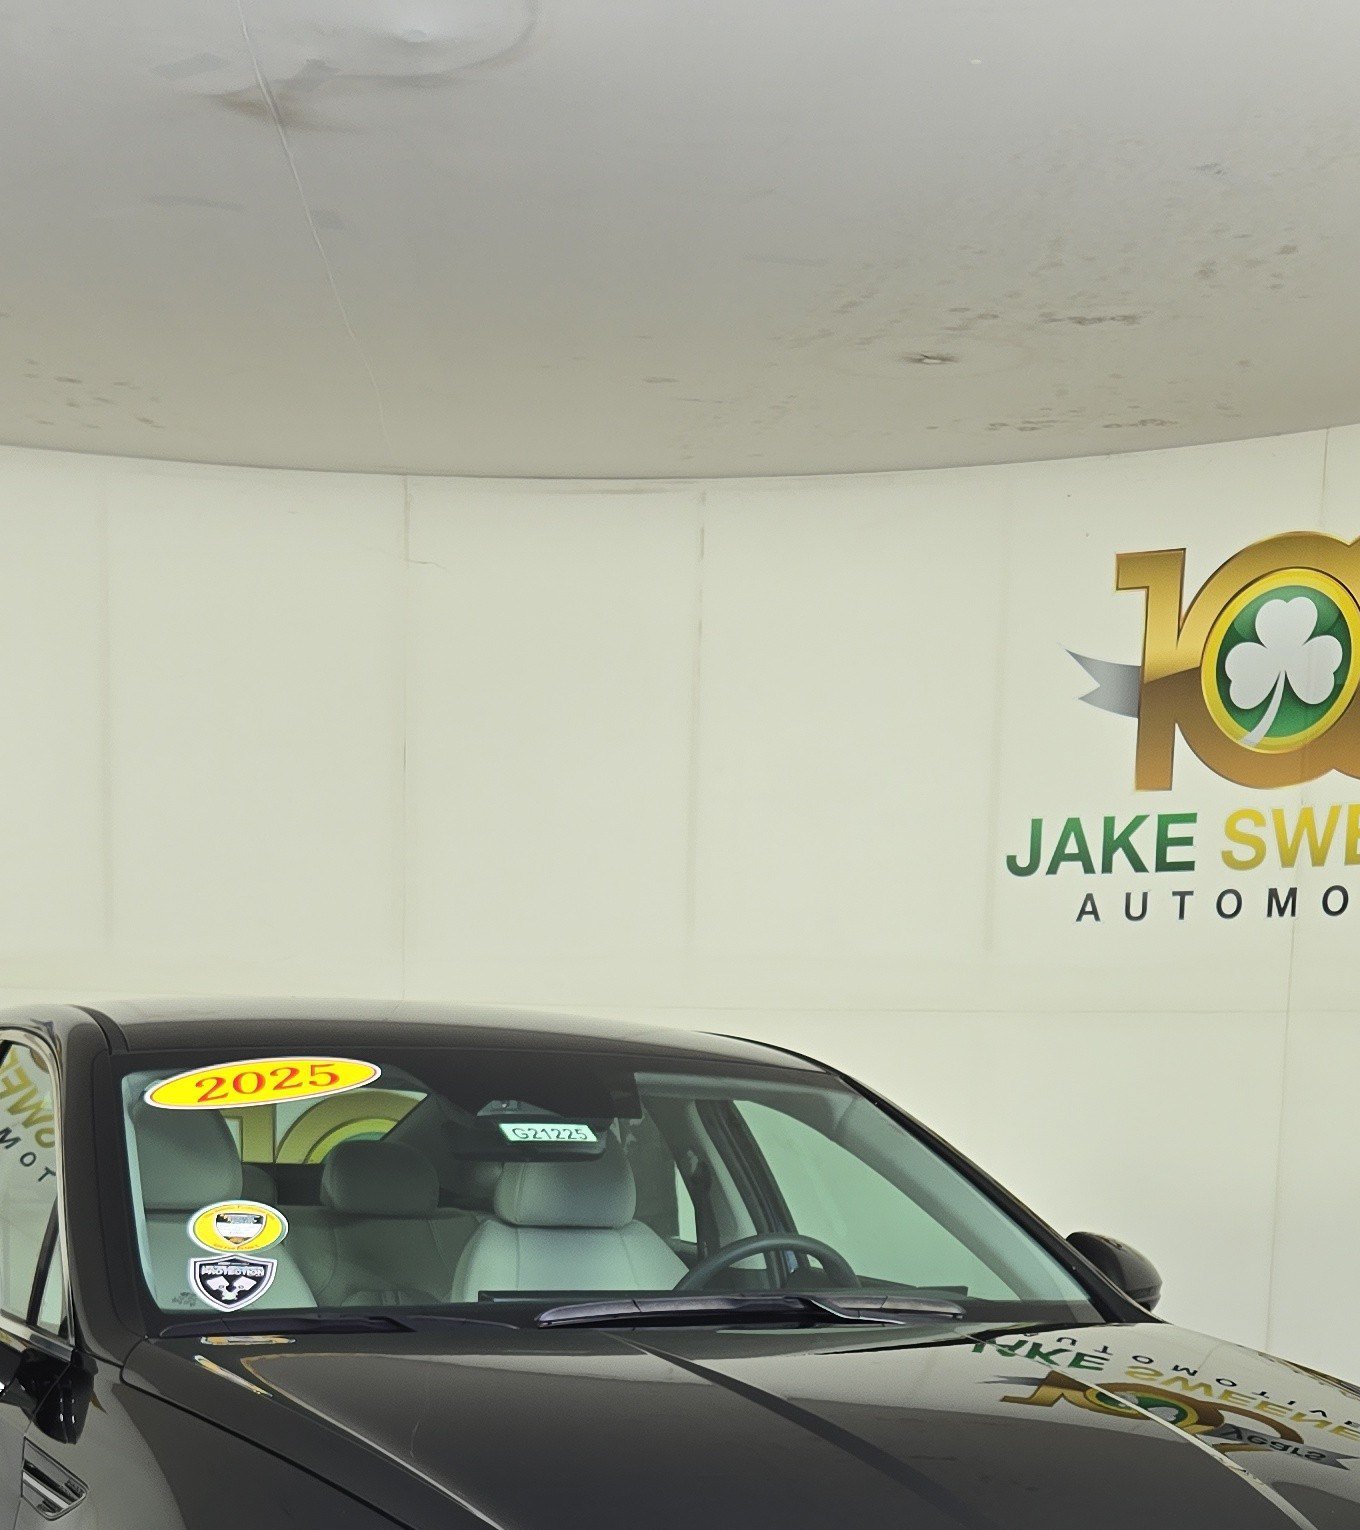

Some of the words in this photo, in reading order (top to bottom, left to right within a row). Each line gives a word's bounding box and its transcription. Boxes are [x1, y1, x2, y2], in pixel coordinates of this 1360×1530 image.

[1005, 812, 1198, 878] JAKE
[194, 1064, 341, 1103] 2025
[512, 1127, 588, 1140] G21225
